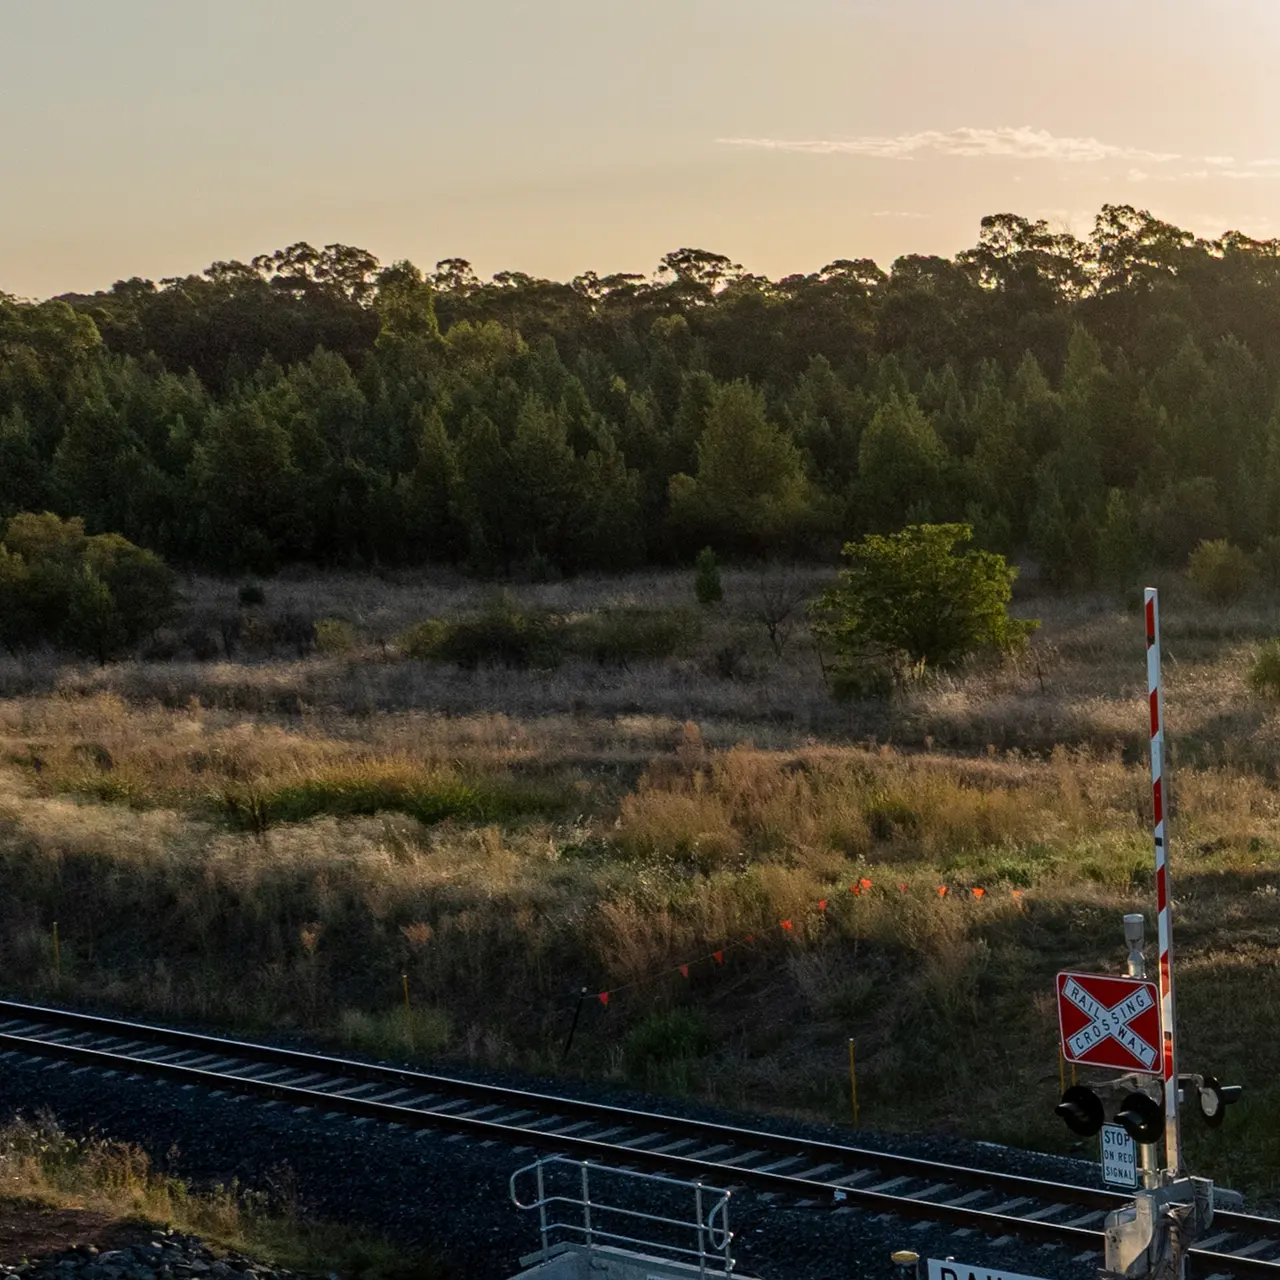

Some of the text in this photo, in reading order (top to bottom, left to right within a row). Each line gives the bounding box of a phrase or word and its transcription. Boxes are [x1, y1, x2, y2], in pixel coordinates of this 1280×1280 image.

[1071, 987, 1147, 1056] RAIL WAY
[1075, 995, 1145, 1050] CROSSING
[1104, 1130, 1130, 1147] STOP
[1104, 1150, 1134, 1164] ON RED
[1106, 1166, 1134, 1180] SIGNAL
